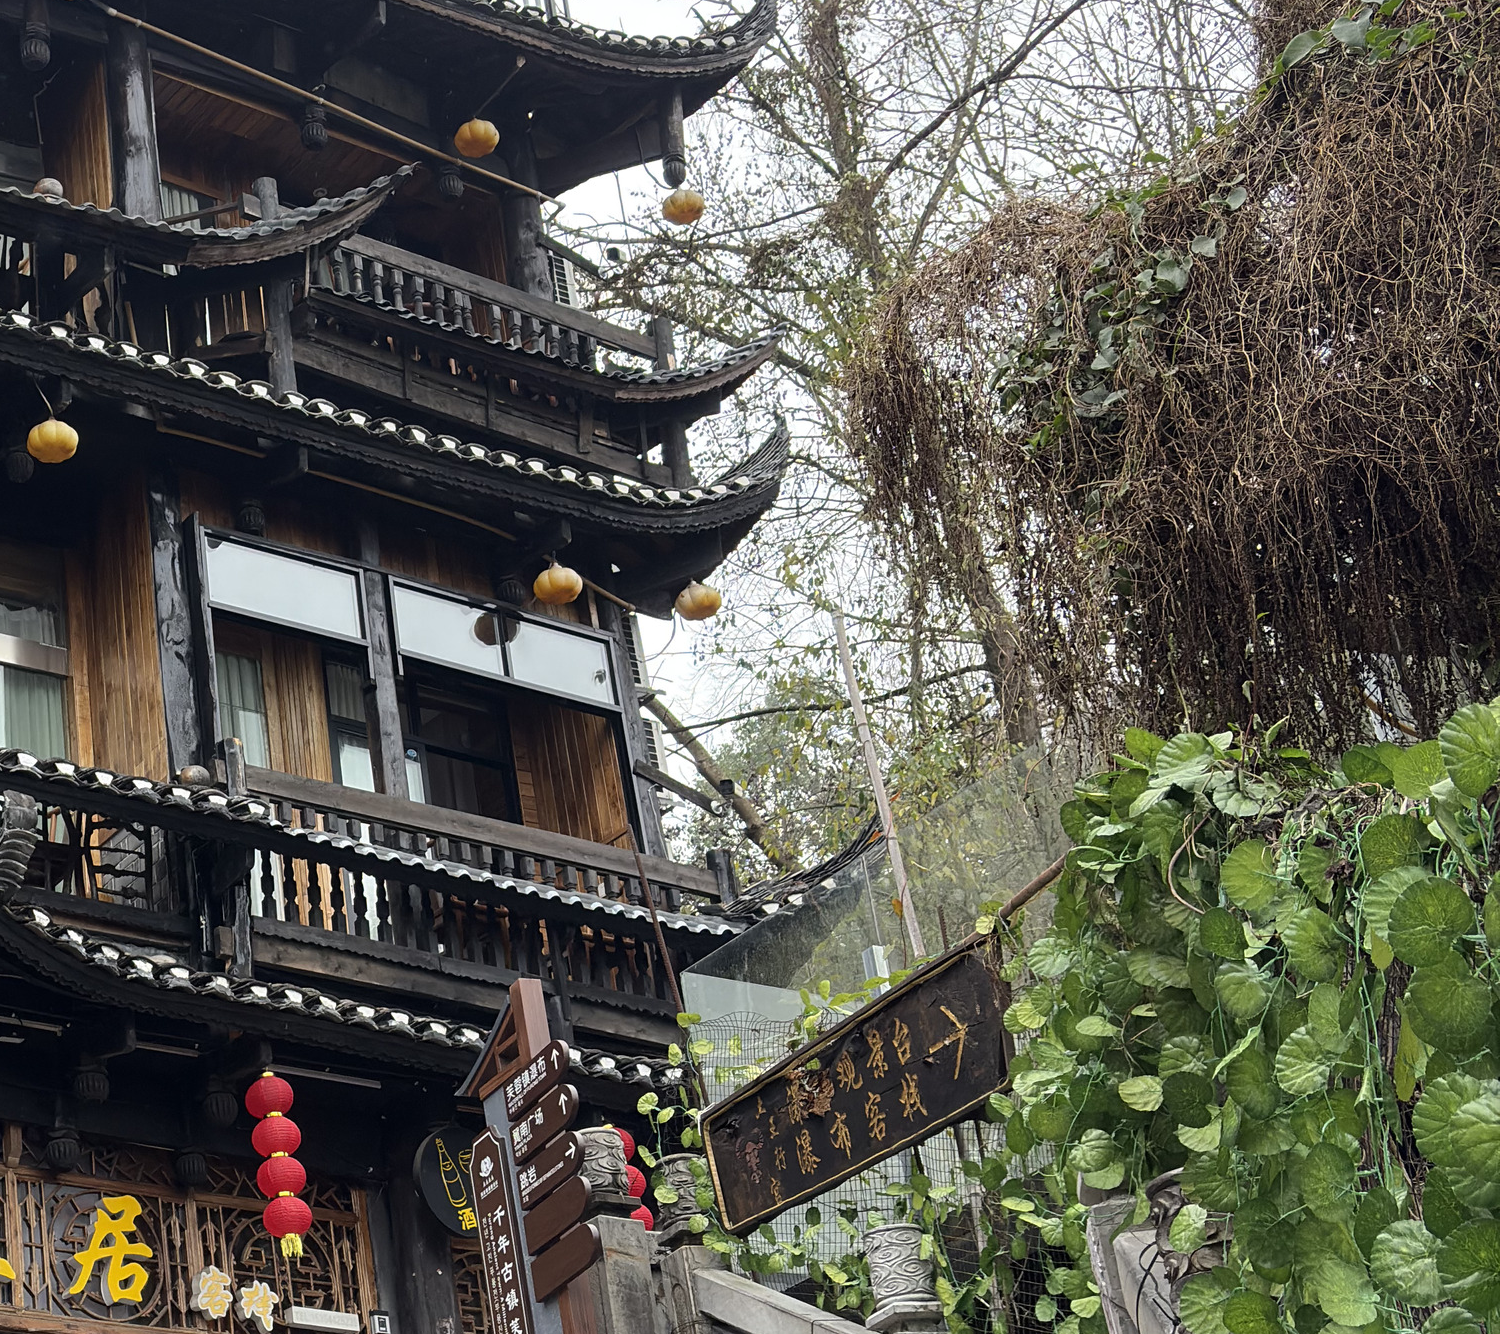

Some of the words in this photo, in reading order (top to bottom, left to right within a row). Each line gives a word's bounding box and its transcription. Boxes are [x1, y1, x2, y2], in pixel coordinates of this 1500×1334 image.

[505, 1055, 546, 1103] 芙蓉镇瀑布
[458, 1207, 478, 1231] 酒
[198, 1265, 279, 1332] 客栈
